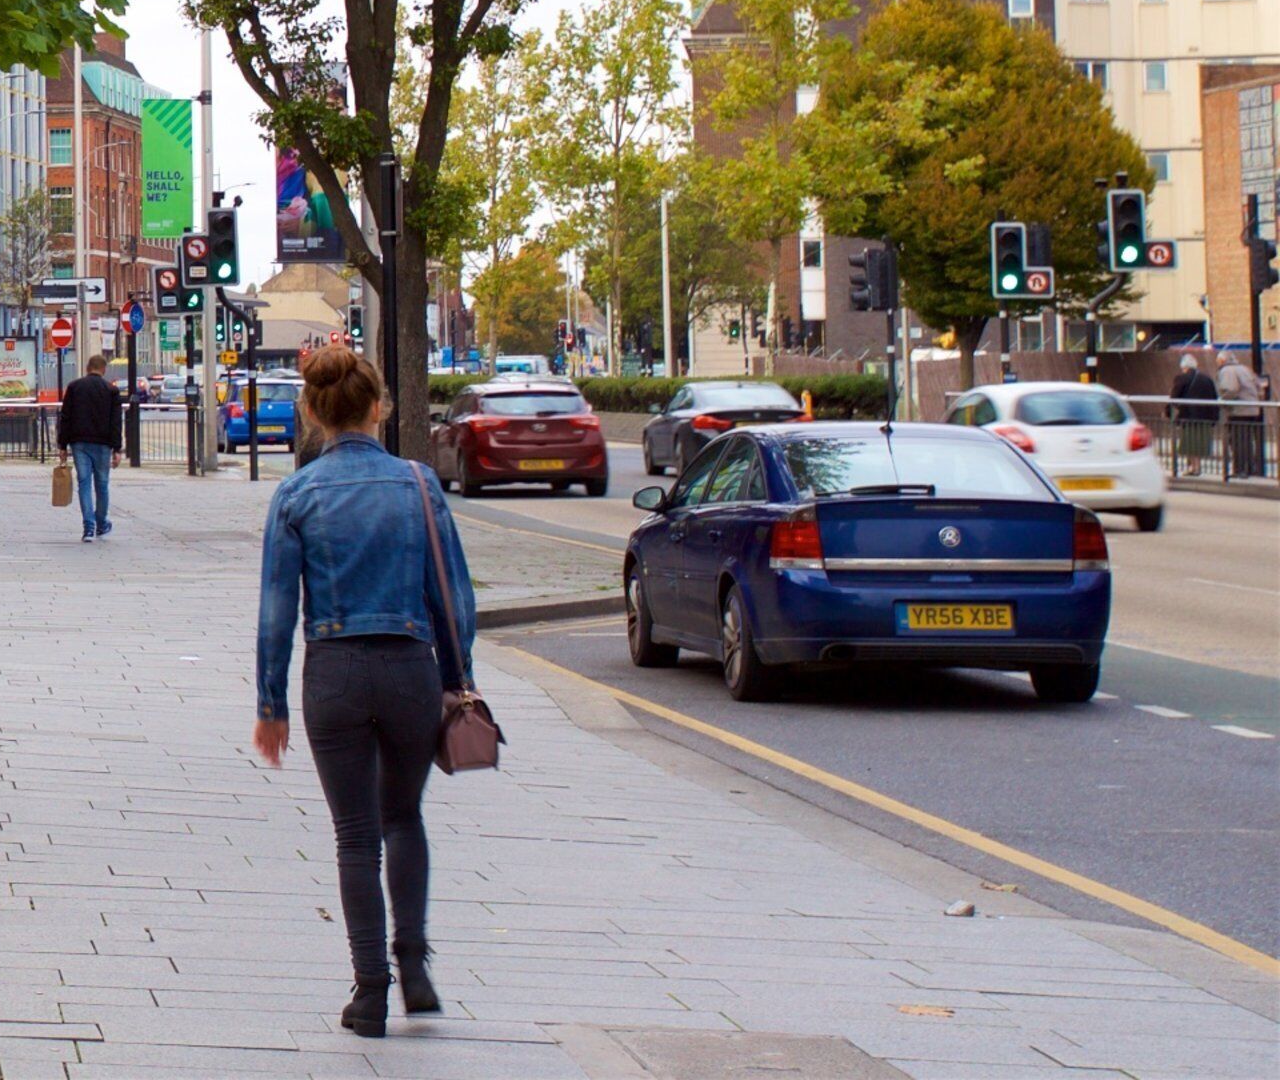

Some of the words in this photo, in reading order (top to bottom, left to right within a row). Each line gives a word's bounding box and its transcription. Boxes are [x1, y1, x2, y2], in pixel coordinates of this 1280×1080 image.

[146, 170, 184, 181] HELLO,
[146, 182, 181, 191] SHALL
[146, 193, 167, 202] WE?
[912, 607, 963, 625] YR56
[969, 608, 1008, 625] XBE
